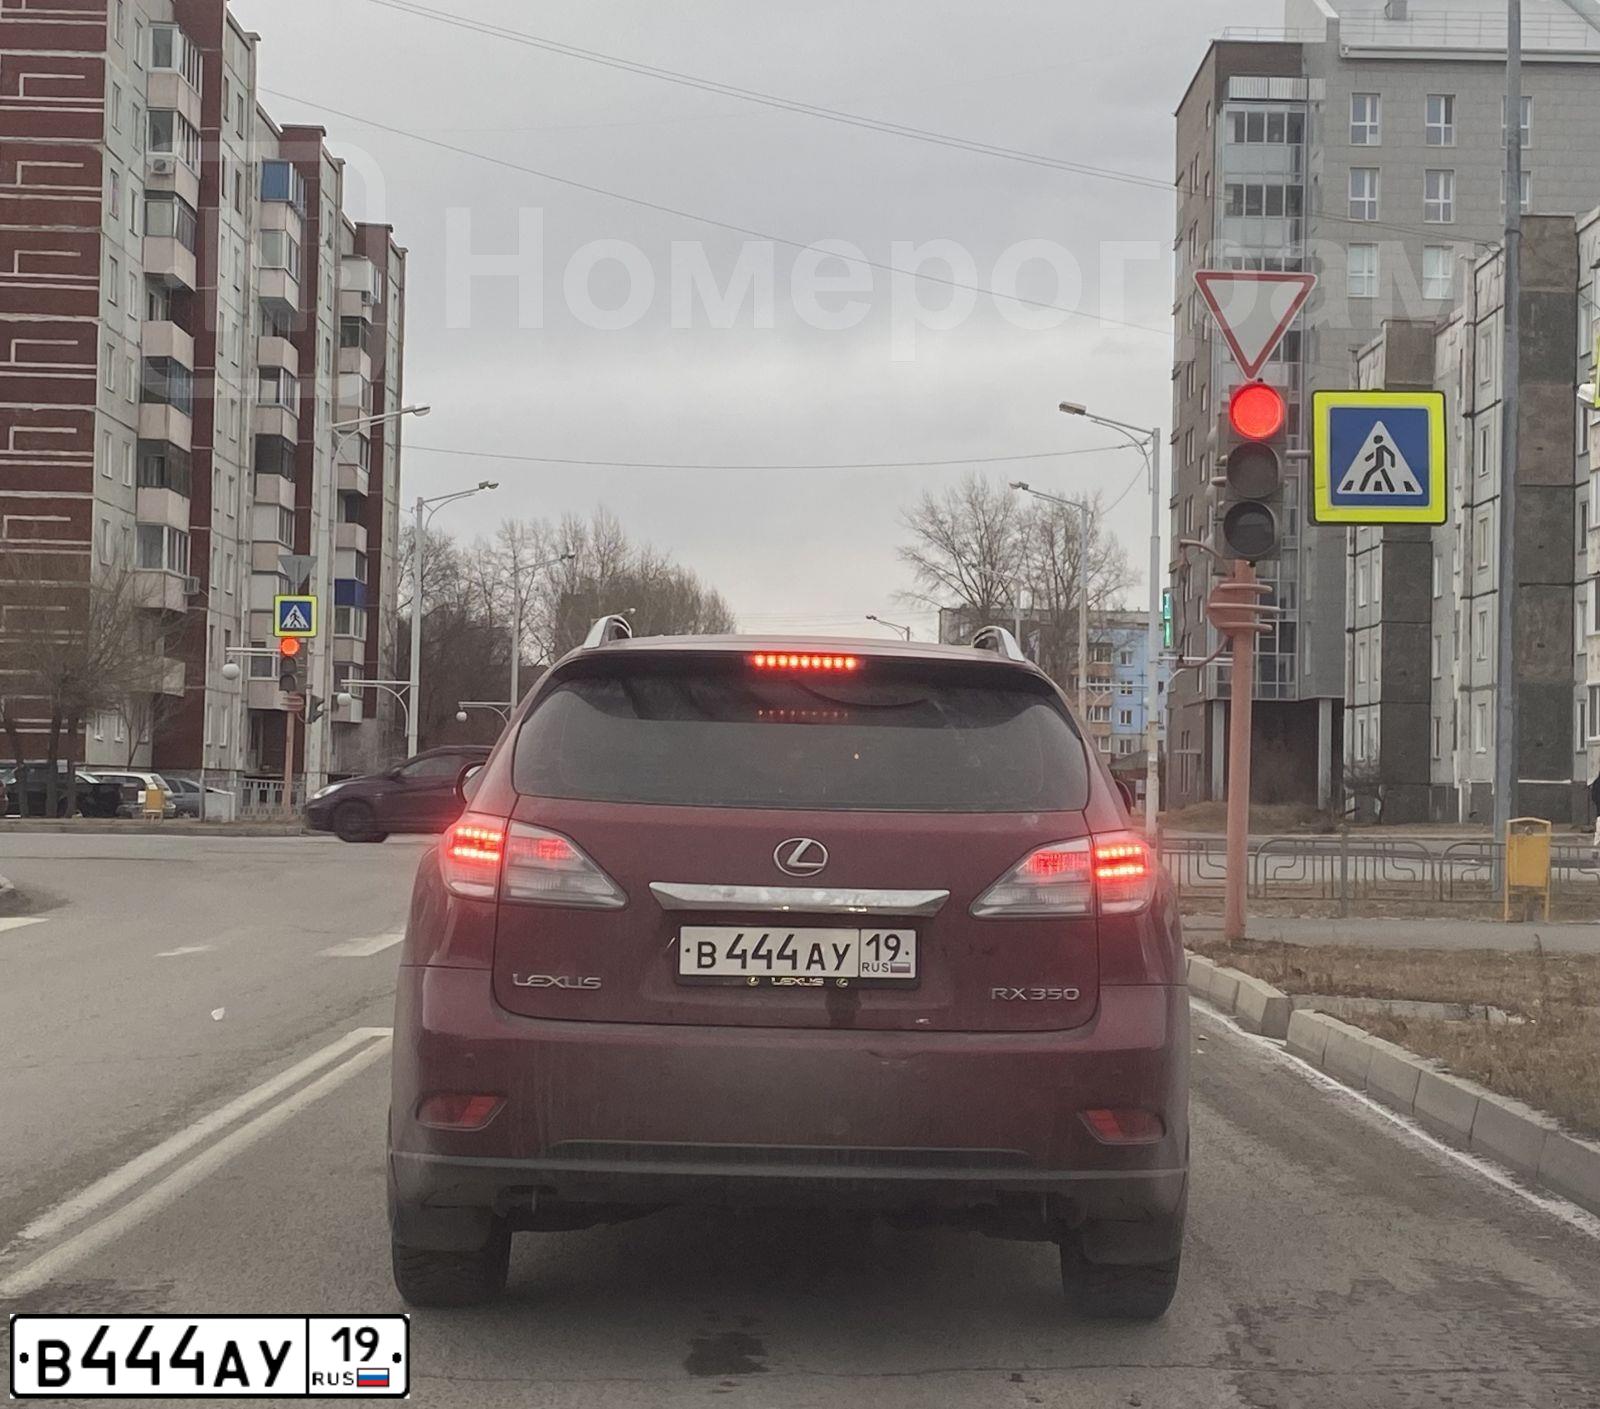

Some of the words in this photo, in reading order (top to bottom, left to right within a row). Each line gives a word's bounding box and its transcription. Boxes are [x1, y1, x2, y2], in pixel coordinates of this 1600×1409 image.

[865, 933, 901, 961] 19
[862, 962, 890, 973] RUS
[512, 973, 602, 990] LEXUS
[771, 977, 825, 987] LEXUS
